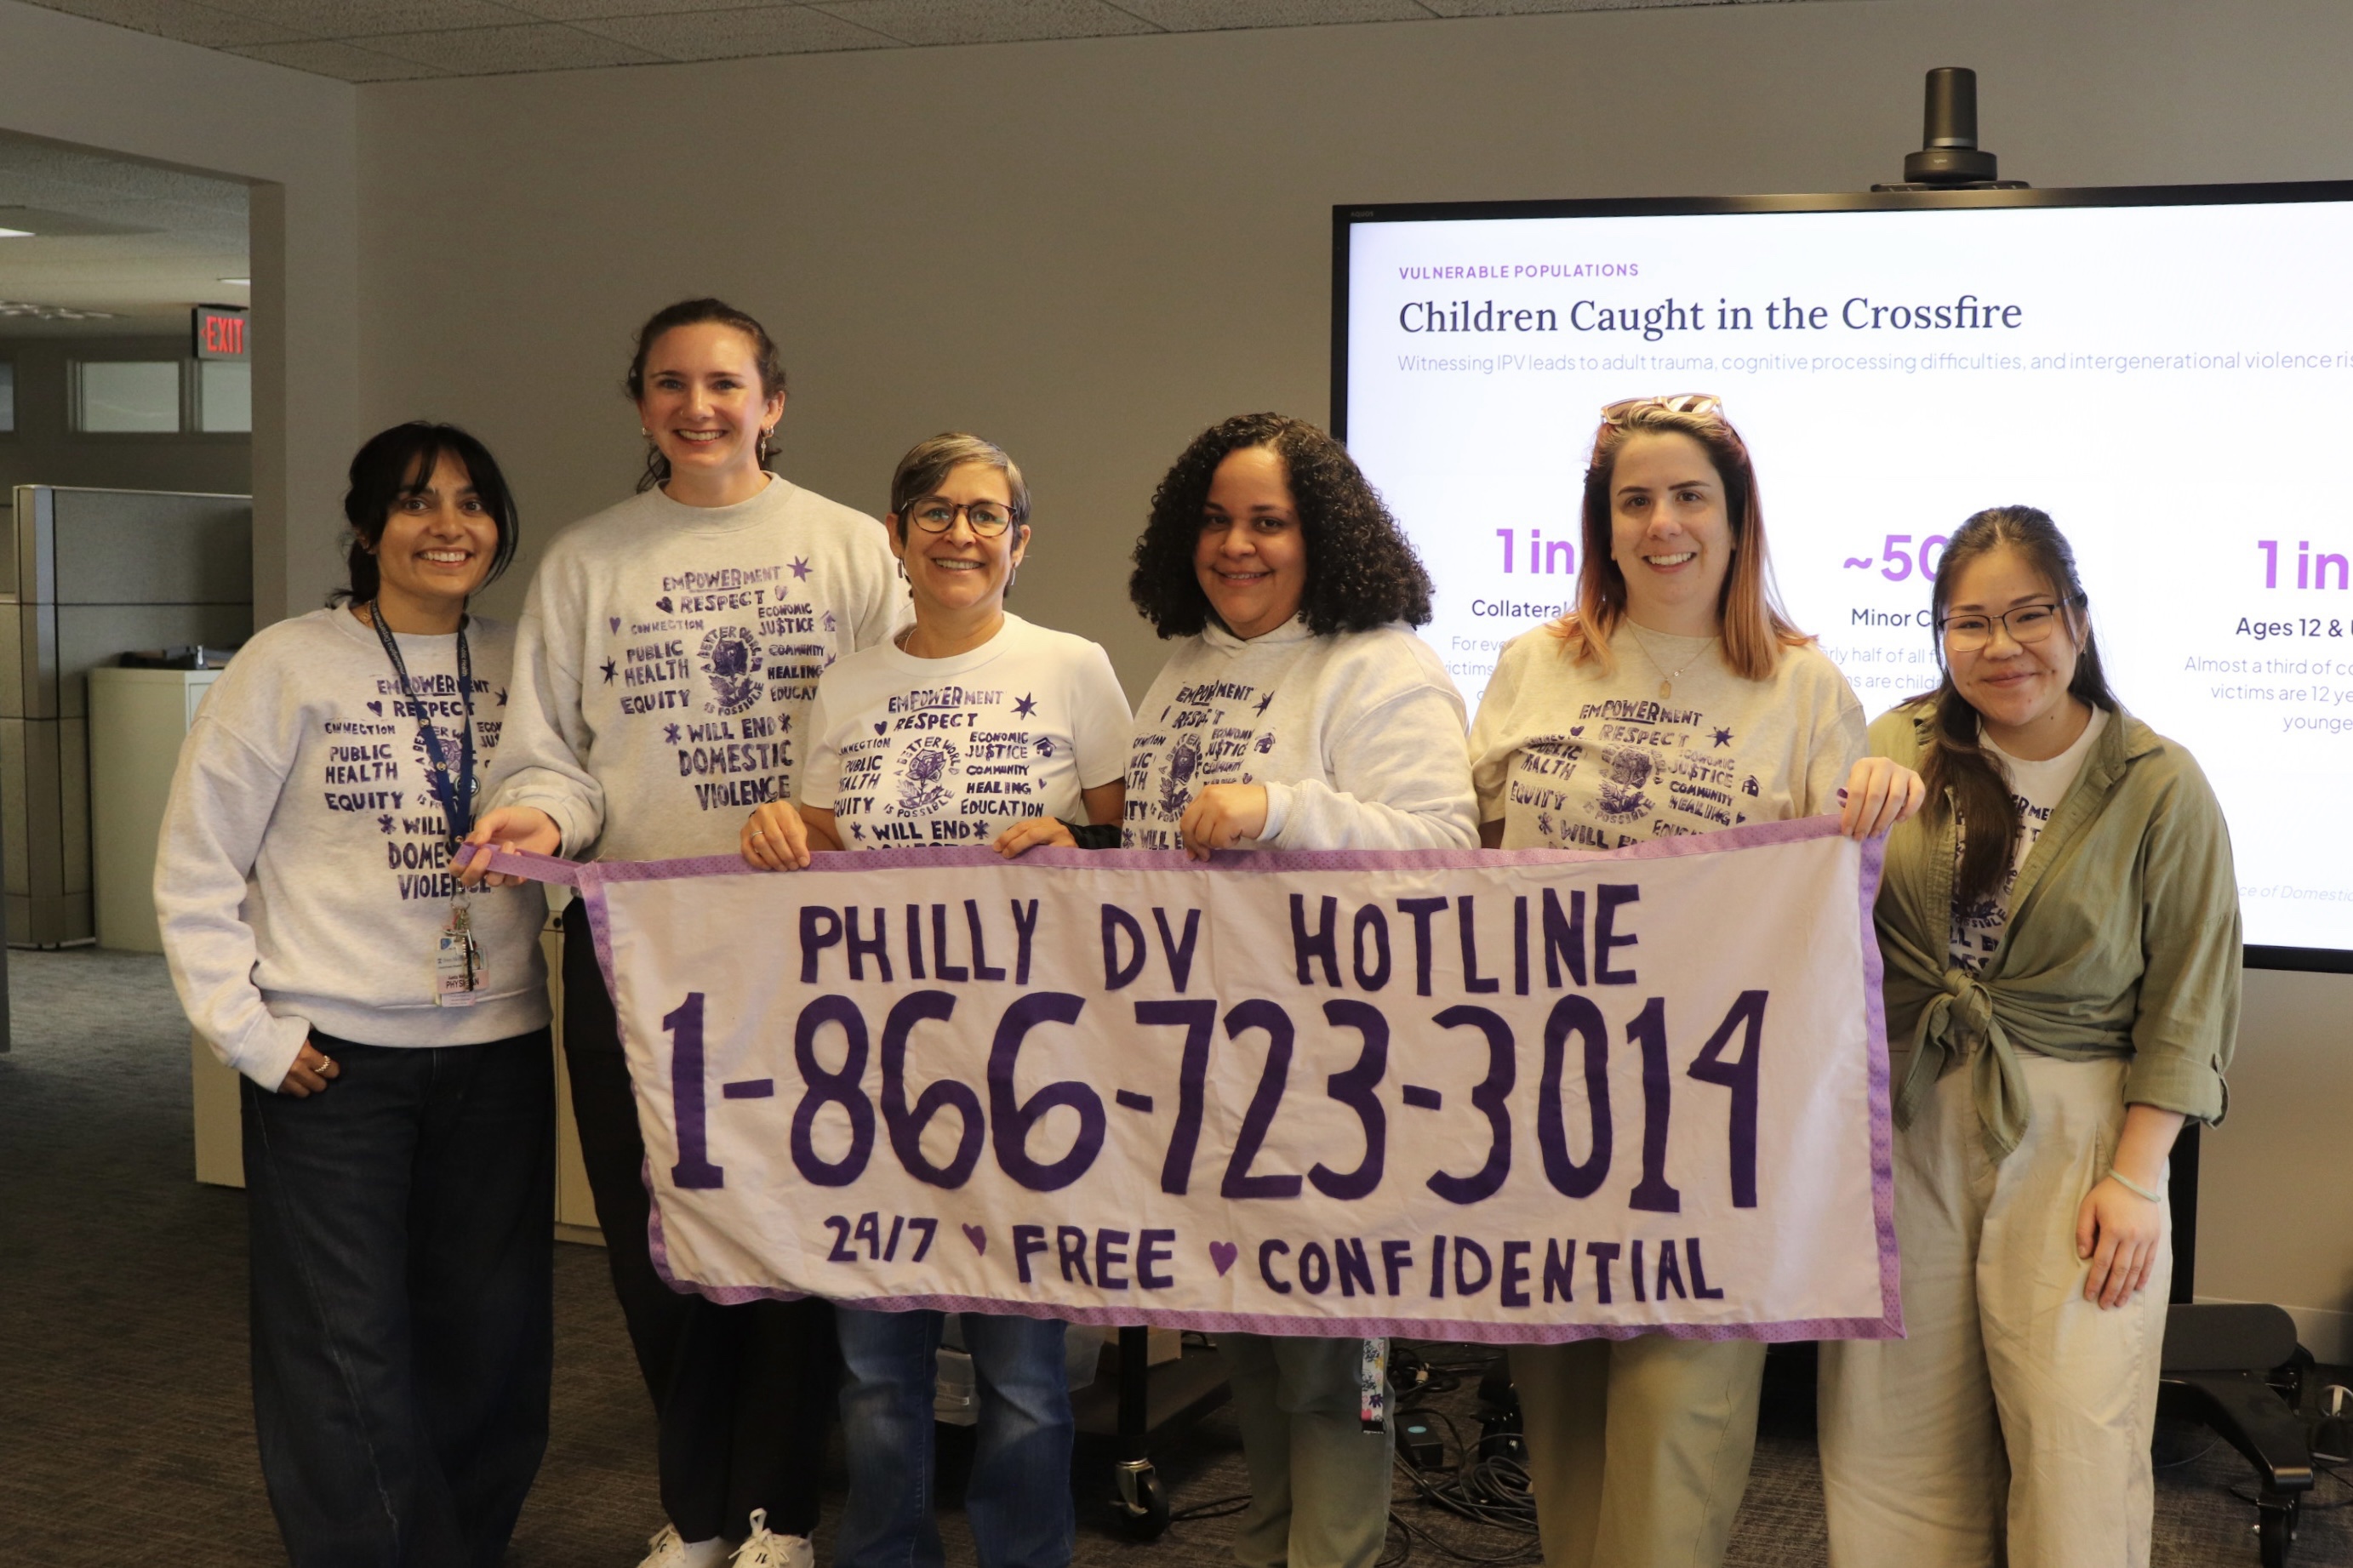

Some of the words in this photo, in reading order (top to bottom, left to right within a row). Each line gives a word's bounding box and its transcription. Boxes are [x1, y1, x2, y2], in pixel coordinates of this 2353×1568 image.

[1399, 265, 1509, 280] VULNERABLE
[1514, 263, 1639, 278] POPULATIONS
[1399, 299, 1558, 333] Children
[1570, 297, 1705, 341] Caught
[1717, 298, 1753, 330] in
[1765, 296, 1828, 330] the
[1842, 294, 2022, 330] Crossfire
[206, 316, 245, 354] EXIT
[1398, 354, 1493, 374] Witnessing
[1497, 355, 1526, 371] IPV
[1528, 353, 1575, 371] leads
[1579, 356, 1598, 370] to
[1602, 353, 1647, 371] adult
[1650, 356, 1718, 373] trauma,
[1722, 353, 1808, 374] cognitive
[1811, 353, 1916, 374] processing
[1920, 351, 2027, 373] difficulties,
[2030, 352, 2066, 370] and
[2070, 351, 2241, 373] intergenerational
[2245, 351, 2332, 368] violence
[1496, 528, 1513, 573] 1
[1531, 528, 1574, 574] in
[1842, 534, 1950, 583] ~50
[2258, 540, 2278, 589] 1
[2298, 540, 2349, 590] in
[663, 567, 782, 591] EMPOWERMENT
[680, 590, 764, 613] RESPECT
[758, 603, 812, 618] ECONOMIC
[1471, 599, 1568, 618] Collateral
[631, 619, 704, 635] CONNECTION
[1851, 608, 1911, 626] Minor
[2236, 617, 2293, 641] Ages
[2299, 619, 2321, 636] 12
[2327, 619, 2344, 637] &
[626, 640, 683, 664] PUBLIC
[768, 644, 825, 657] COMMUNITY
[1452, 636, 1477, 651] For
[1852, 647, 1882, 663] half
[1885, 647, 1904, 663] of
[1907, 648, 1926, 664] all
[2185, 656, 2247, 673] Almost
[2252, 661, 2262, 673] a
[2266, 658, 2308, 675] third
[2311, 659, 2332, 675] of
[625, 659, 690, 687] HEALTH
[768, 664, 824, 680] HEALING
[1445, 660, 1494, 676] ictims
[1865, 676, 1891, 688] are
[2211, 683, 2274, 700] victims
[2278, 687, 2307, 701] are
[2311, 685, 2330, 702] 12
[620, 689, 690, 714] EQUITY
[770, 685, 817, 702] EDUCAT
[888, 687, 1003, 714] EMPOWERMENT
[894, 712, 978, 732] RESPECT
[1579, 699, 1703, 727] EMPOWERMENT
[325, 722, 396, 735] CONNECTION
[687, 721, 734, 743] WILL
[741, 716, 776, 739] END
[1598, 724, 1690, 747] RESPECT
[2282, 716, 2353, 734] younge
[969, 732, 1029, 744] ECONOMIC
[330, 744, 393, 762] PUBLIC
[678, 739, 794, 777] DOMESTIC
[897, 736, 942, 765] BETTER
[943, 739, 961, 775] WORLD
[325, 761, 398, 784] HEALTH
[845, 755, 883, 774] PUBLIC
[966, 764, 1030, 775] COMMUNITY
[967, 780, 1031, 795] HEALING
[1126, 770, 1148, 790] LTH
[324, 791, 404, 813] EQUITY
[694, 775, 791, 811] VIOLENCE
[883, 804, 894, 814] IS
[897, 789, 955, 818] POSSIBLE
[1510, 780, 1568, 810] EQUITY
[1670, 780, 1733, 807] COMMUNITY
[960, 798, 1044, 818] EDUCATION
[1124, 800, 1148, 820] ITY
[1669, 795, 1730, 826] HEALING
[403, 816, 447, 835] WILL
[871, 821, 922, 841] WILL
[931, 820, 971, 840] END
[1560, 819, 1609, 849] WILL
[1139, 829, 1169, 850] WILL
[2260, 885, 2279, 898] of
[799, 898, 1039, 984] PHILLY
[1101, 902, 1202, 993] DV
[1289, 883, 1639, 997] HOTLINE
[662, 989, 1769, 1213] 1-866-723-3014
[823, 1211, 939, 1263] 24/7
[1011, 1224, 1176, 1291] FREE
[1258, 1234, 1724, 1309] CONFIDENTIAL
